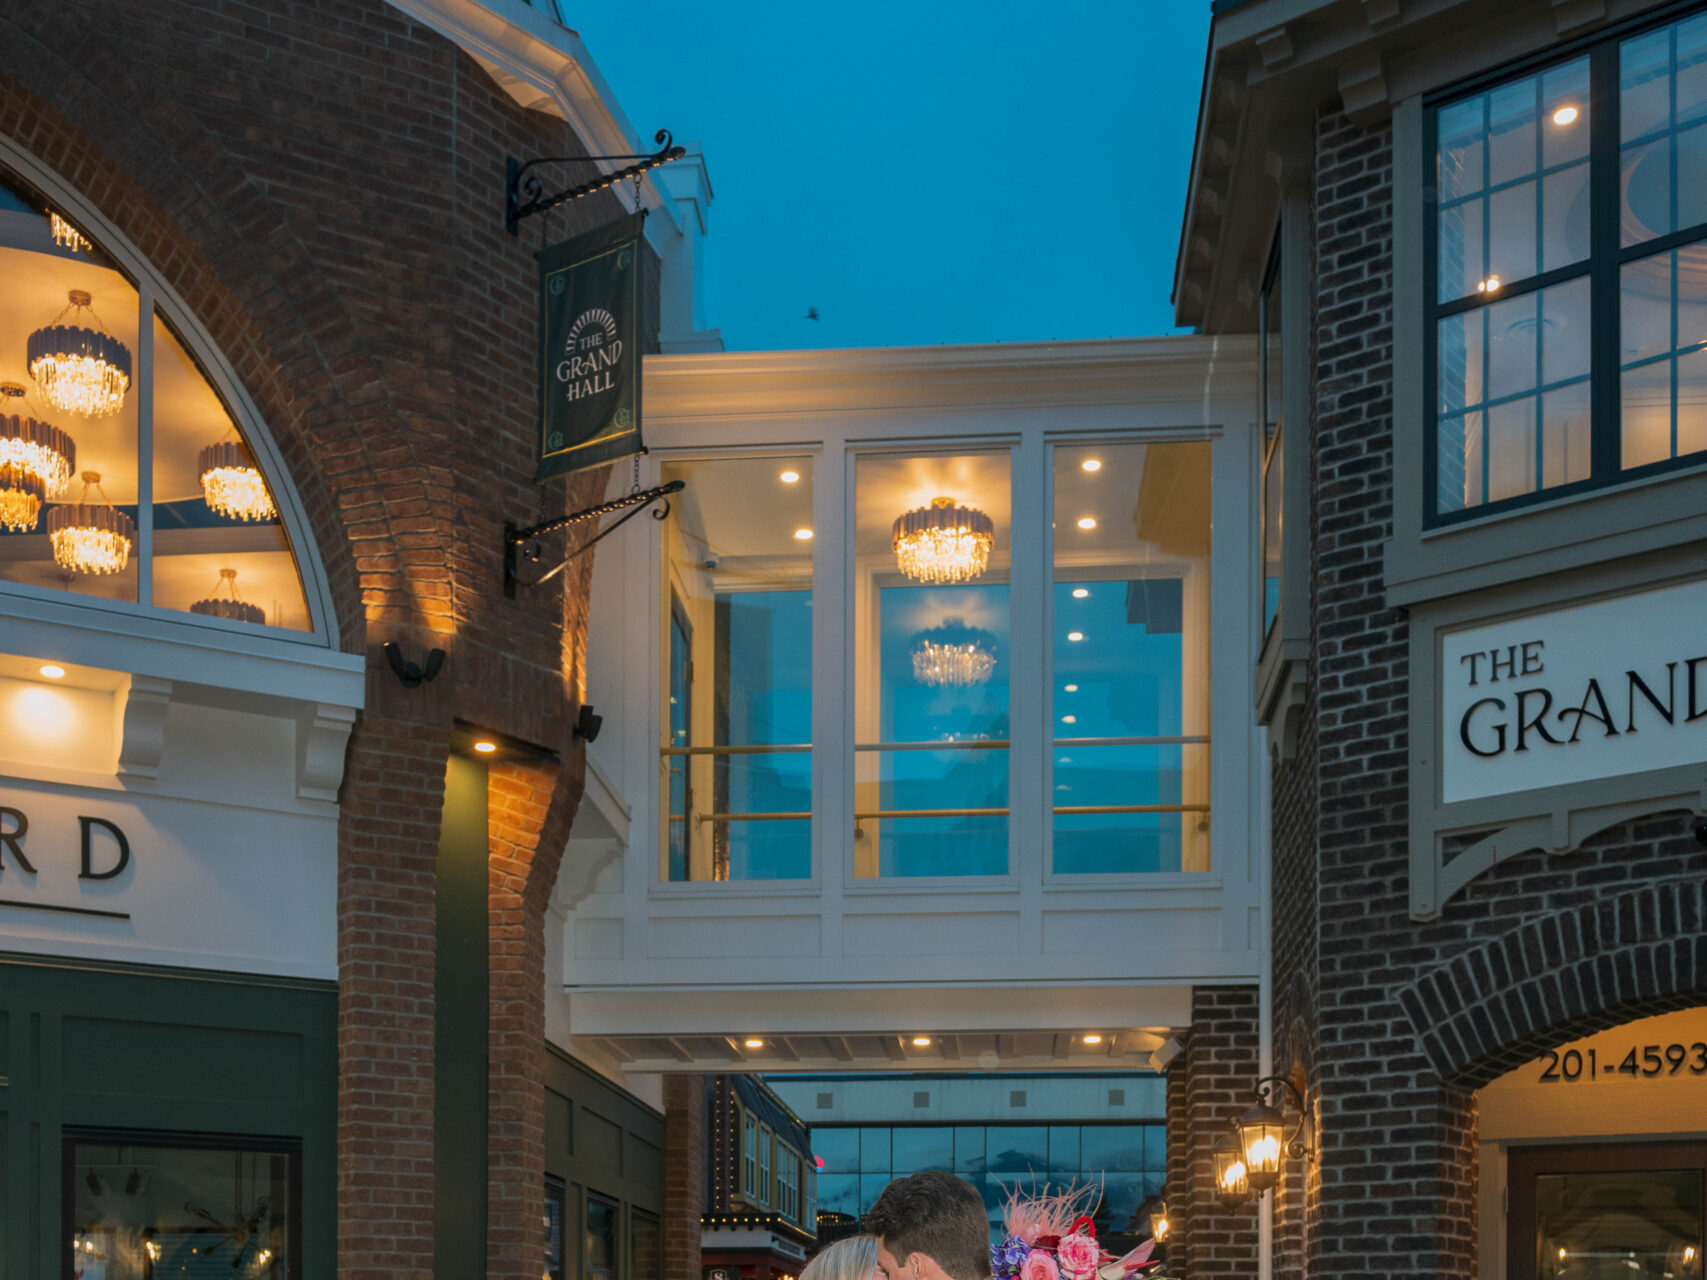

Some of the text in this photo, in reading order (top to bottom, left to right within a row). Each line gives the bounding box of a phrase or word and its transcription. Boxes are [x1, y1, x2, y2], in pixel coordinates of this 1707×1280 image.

[556, 339, 623, 382] GRAND
[579, 332, 604, 351] THE
[567, 371, 615, 402] HALL
[1460, 640, 1545, 686] THE
[1539, 1042, 1707, 1083] 201-4593
